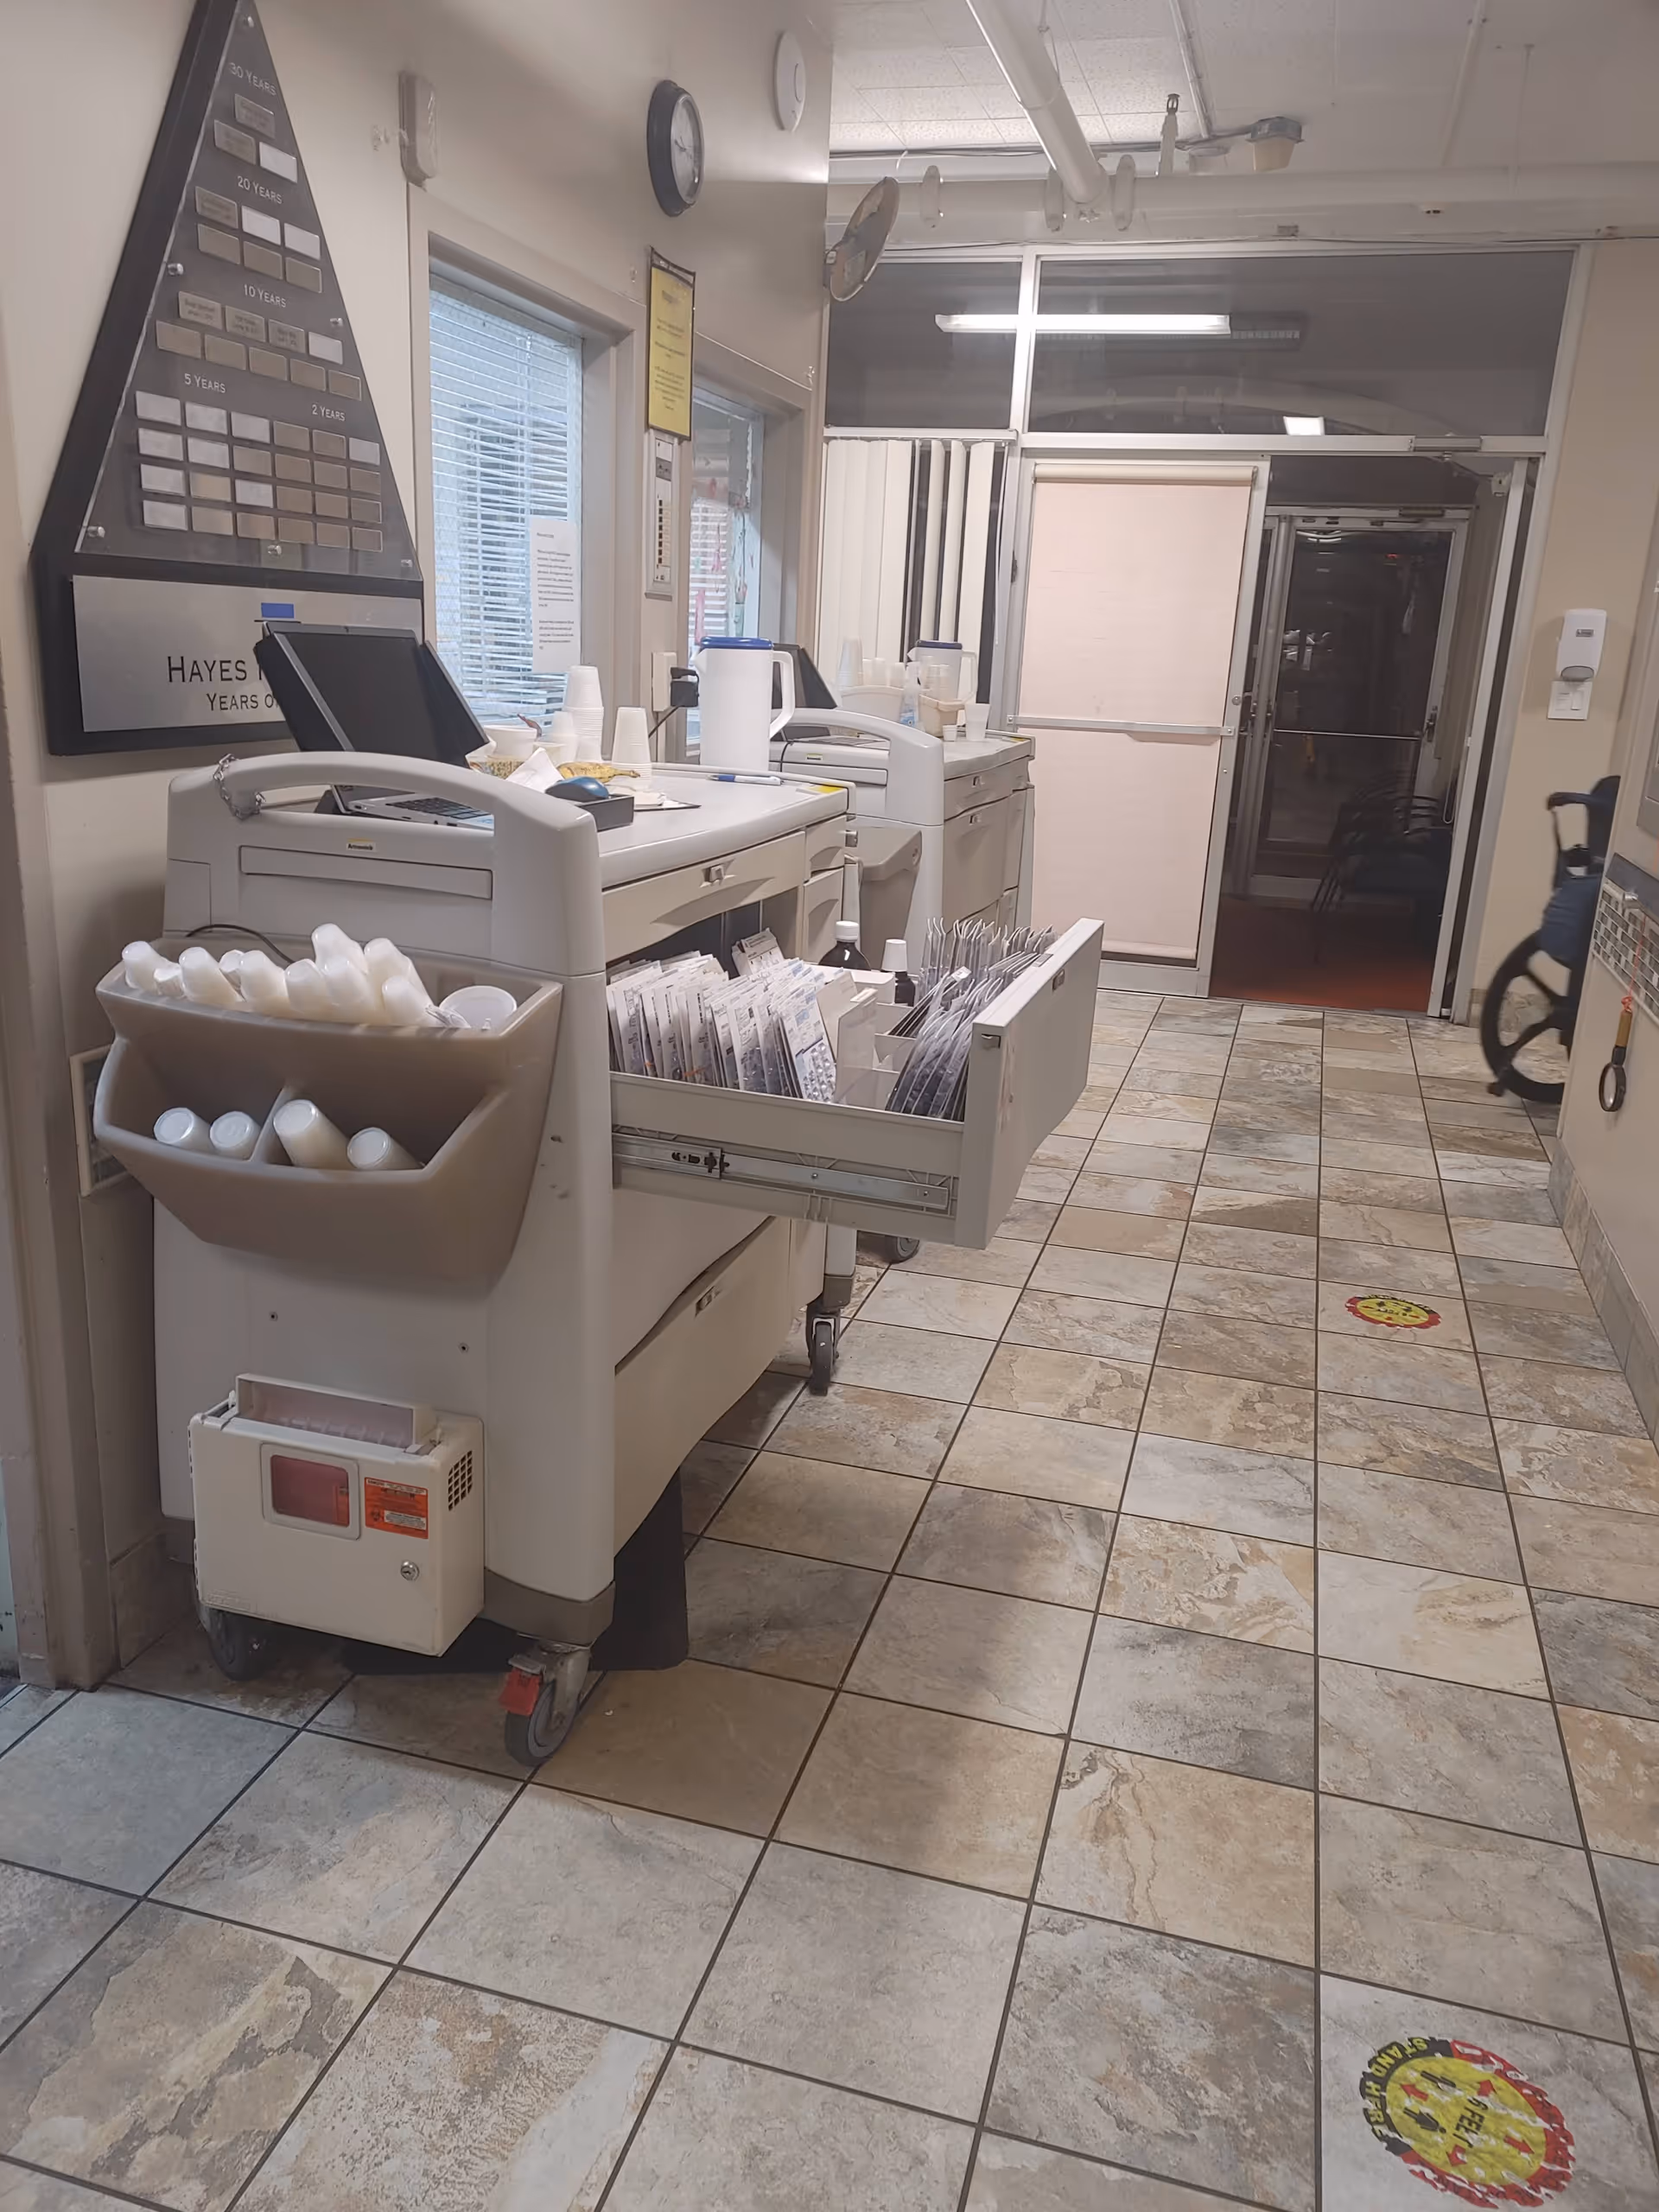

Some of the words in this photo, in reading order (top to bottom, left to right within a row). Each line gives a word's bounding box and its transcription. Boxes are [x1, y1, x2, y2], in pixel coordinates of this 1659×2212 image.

[229, 61, 244, 79] 30
[246, 68, 277, 97] YEARS
[237, 175, 251, 190] 20
[251, 180, 283, 205] YEARS
[243, 283, 256, 298] 10
[257, 289, 287, 308] YEARS
[184, 373, 192, 385] 5
[194, 376, 226, 394] YEARS
[311, 404, 319, 416] 2
[320, 405, 346, 422] YEARS
[167, 656, 248, 683] HAYES
[206, 693, 259, 711] YEARS
[1370, 2037, 1428, 2079] STAND
[1467, 2096, 1489, 2112] 6
[1452, 2105, 1486, 2150] FEET
